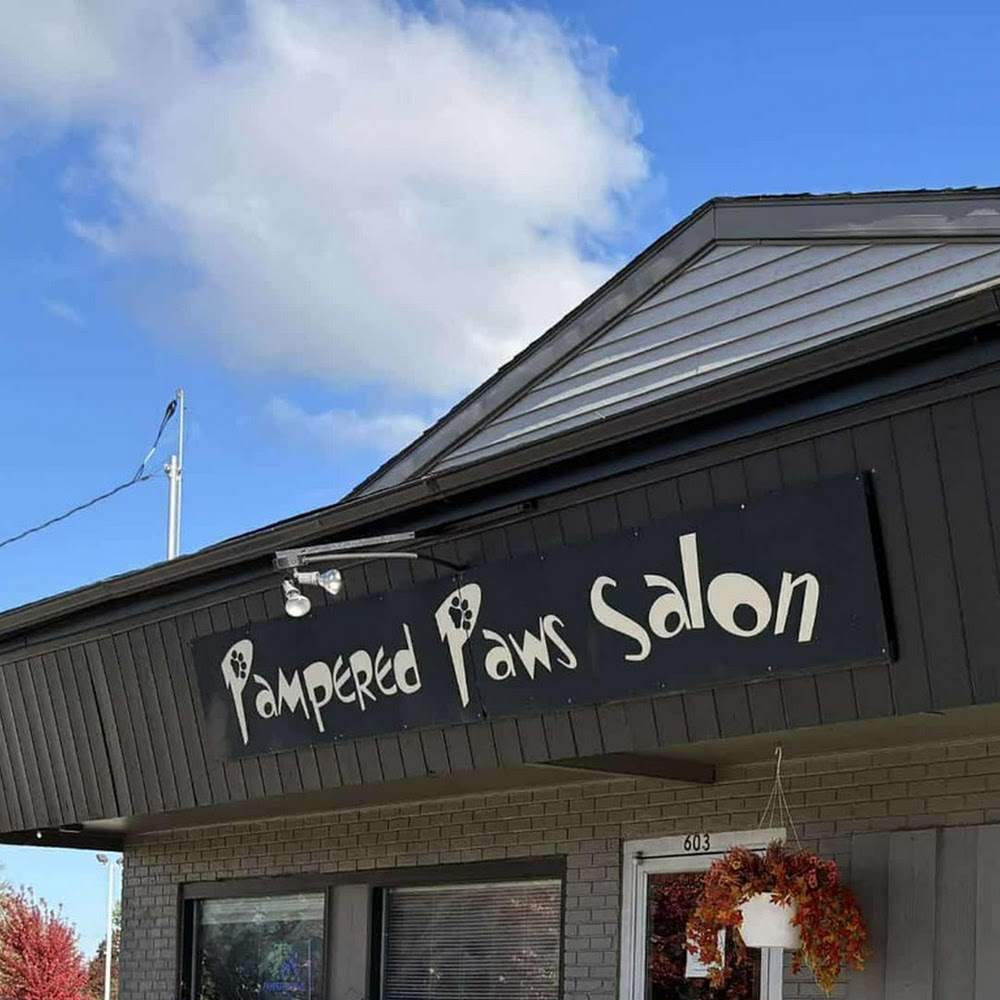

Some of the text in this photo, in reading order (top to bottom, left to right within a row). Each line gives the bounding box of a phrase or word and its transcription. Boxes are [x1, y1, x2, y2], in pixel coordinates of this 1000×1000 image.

[435, 582, 578, 708] Paws
[590, 532, 820, 662] Salon
[683, 833, 711, 852] 603
